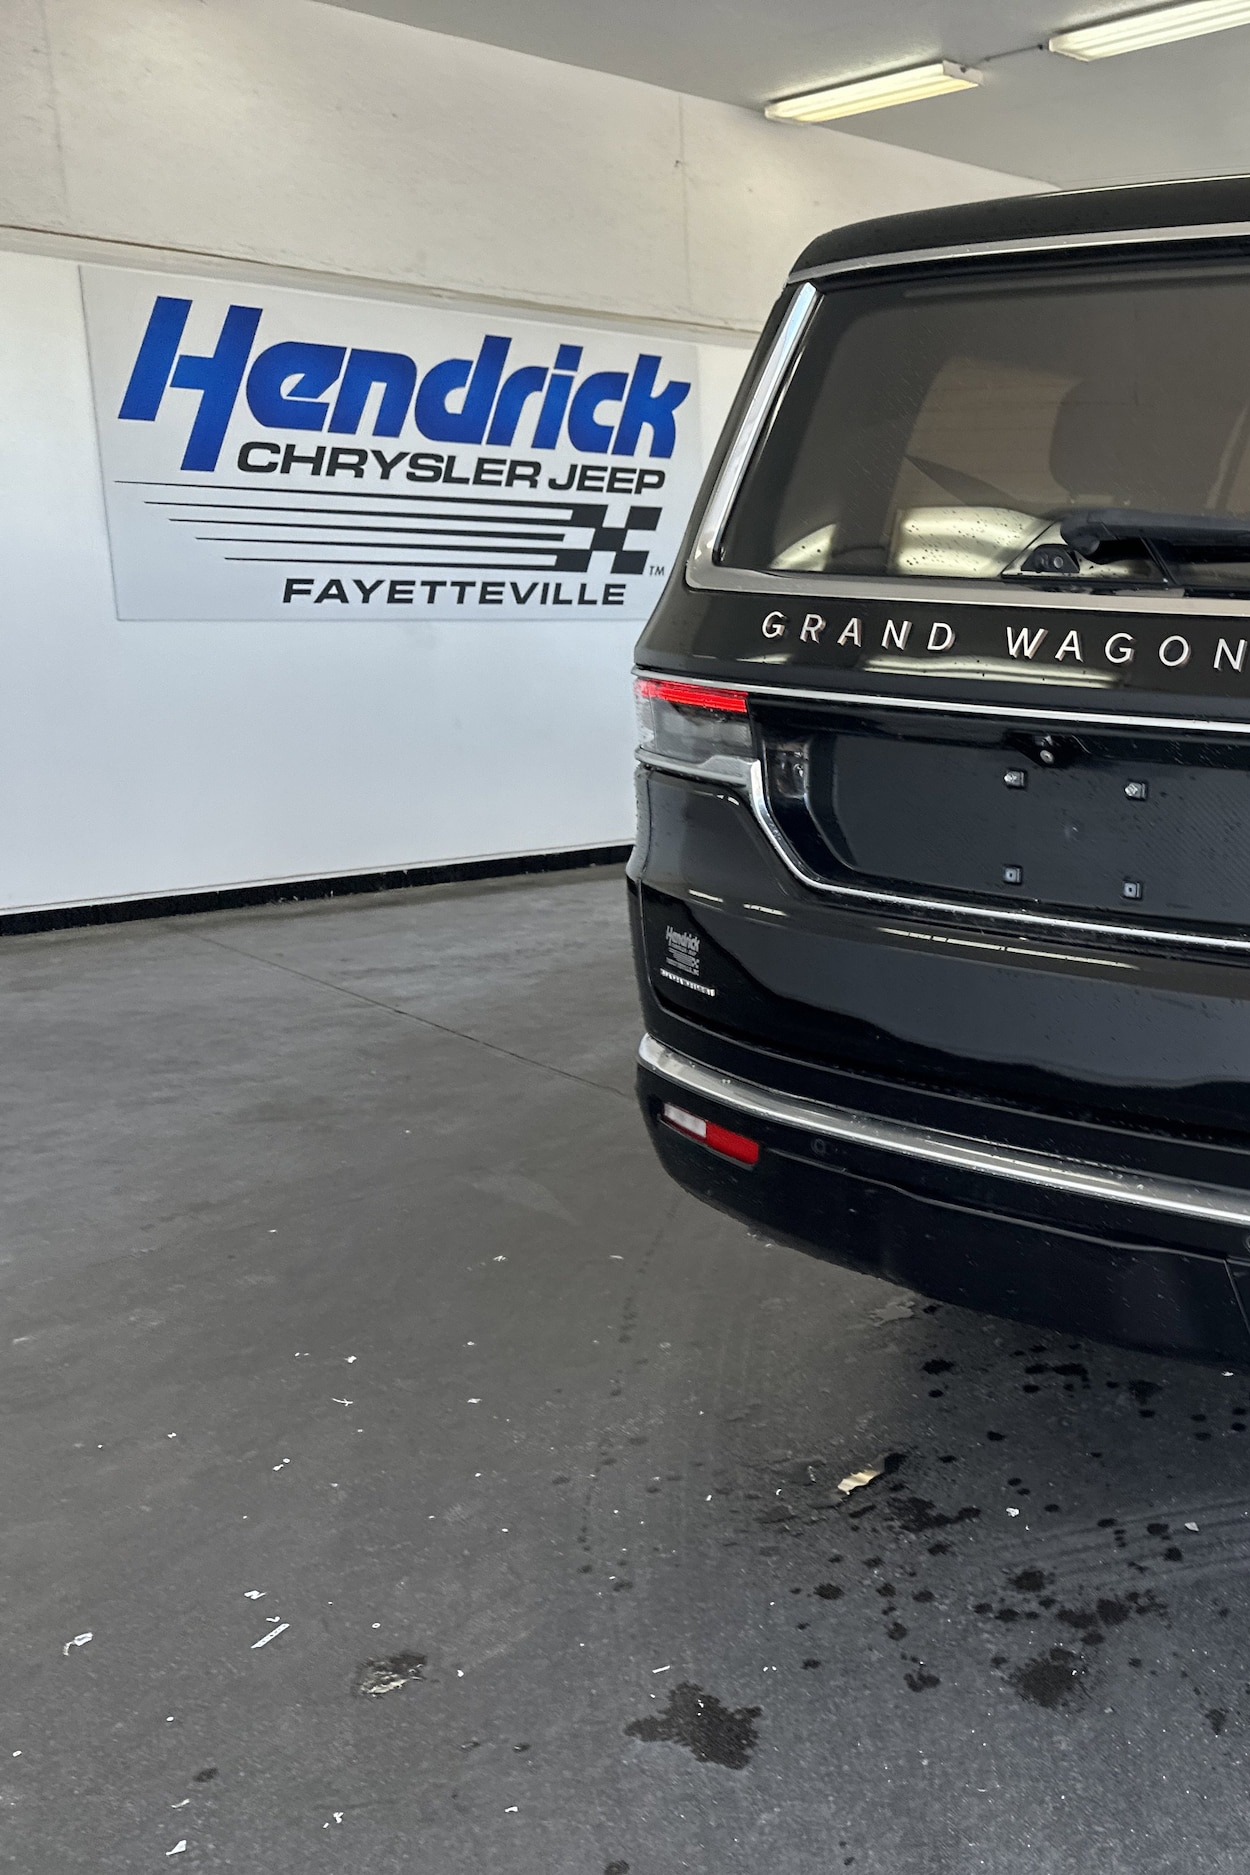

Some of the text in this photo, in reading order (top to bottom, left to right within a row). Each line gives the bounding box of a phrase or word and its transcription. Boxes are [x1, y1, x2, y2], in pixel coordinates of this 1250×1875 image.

[118, 296, 691, 472] Hendrick
[237, 442, 666, 495] CHRYSLER JEEP
[282, 578, 627, 606] FAYETTEVILLE
[648, 565, 665, 577] TM
[761, 610, 956, 652] GRAND
